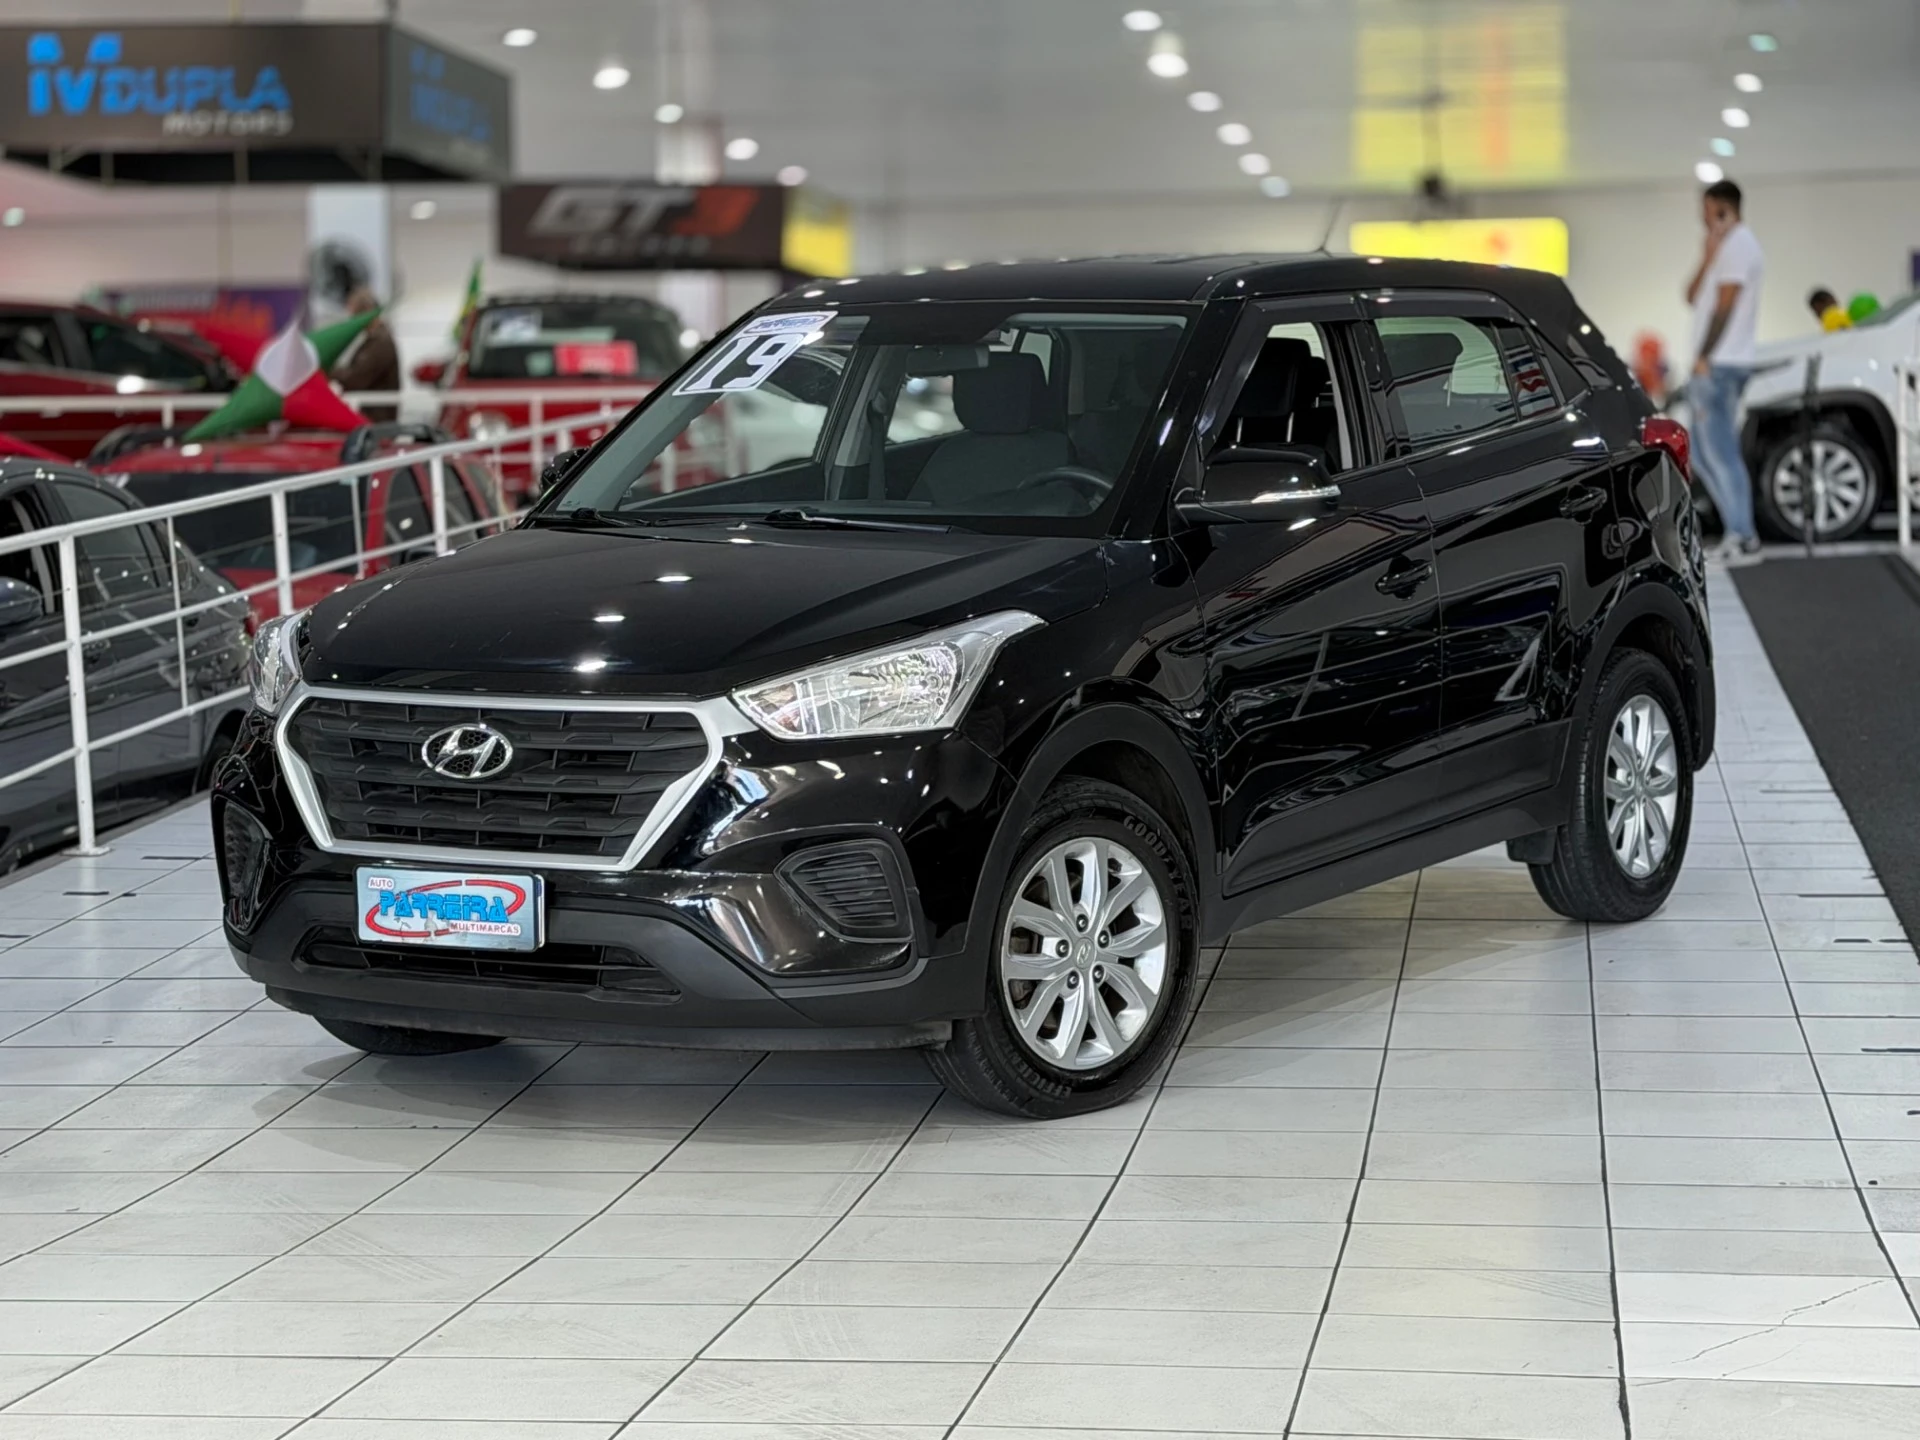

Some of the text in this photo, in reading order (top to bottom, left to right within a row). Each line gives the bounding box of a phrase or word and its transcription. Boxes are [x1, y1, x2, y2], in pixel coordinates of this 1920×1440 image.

[684, 333, 805, 390] 19
[368, 878, 394, 889] AUTO
[379, 890, 510, 923] PARREIRA
[450, 922, 520, 935] MULTIMARCAS
